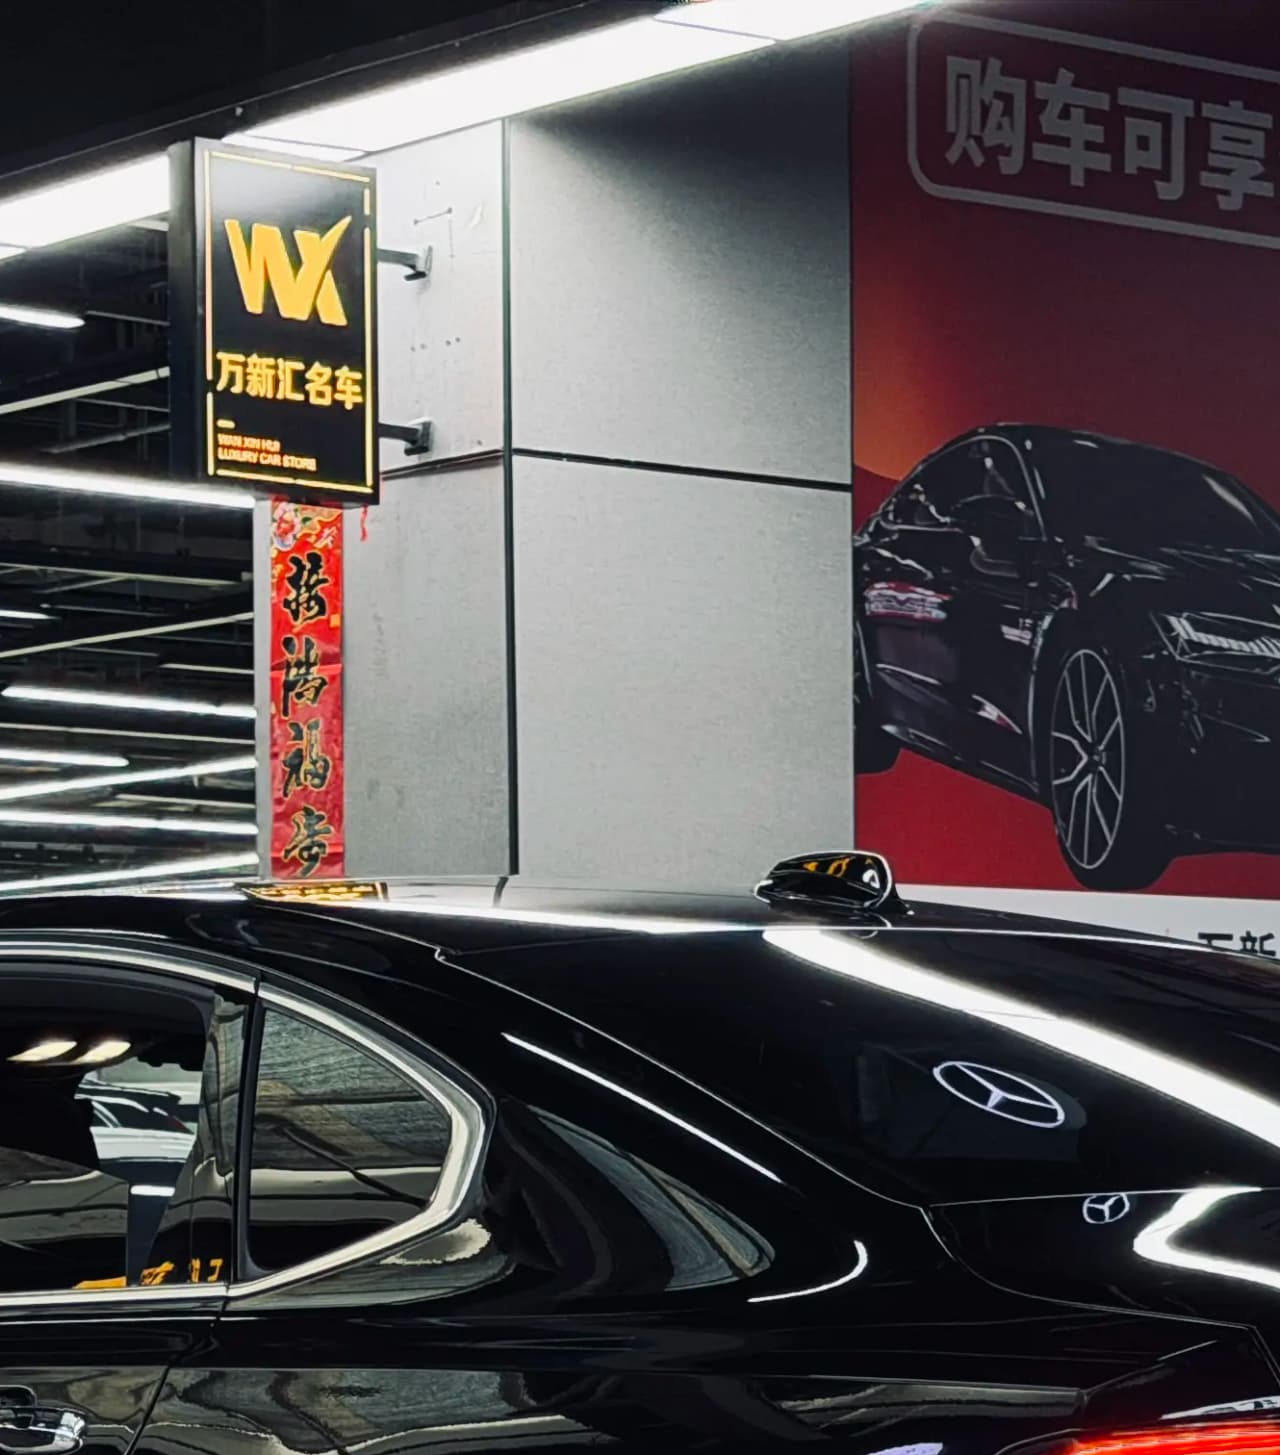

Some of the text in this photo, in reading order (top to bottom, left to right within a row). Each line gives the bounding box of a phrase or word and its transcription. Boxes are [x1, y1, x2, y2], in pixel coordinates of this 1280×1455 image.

[215, 351, 364, 411] 万新汇名车
[217, 447, 318, 472] LUXURY CAR STORE
